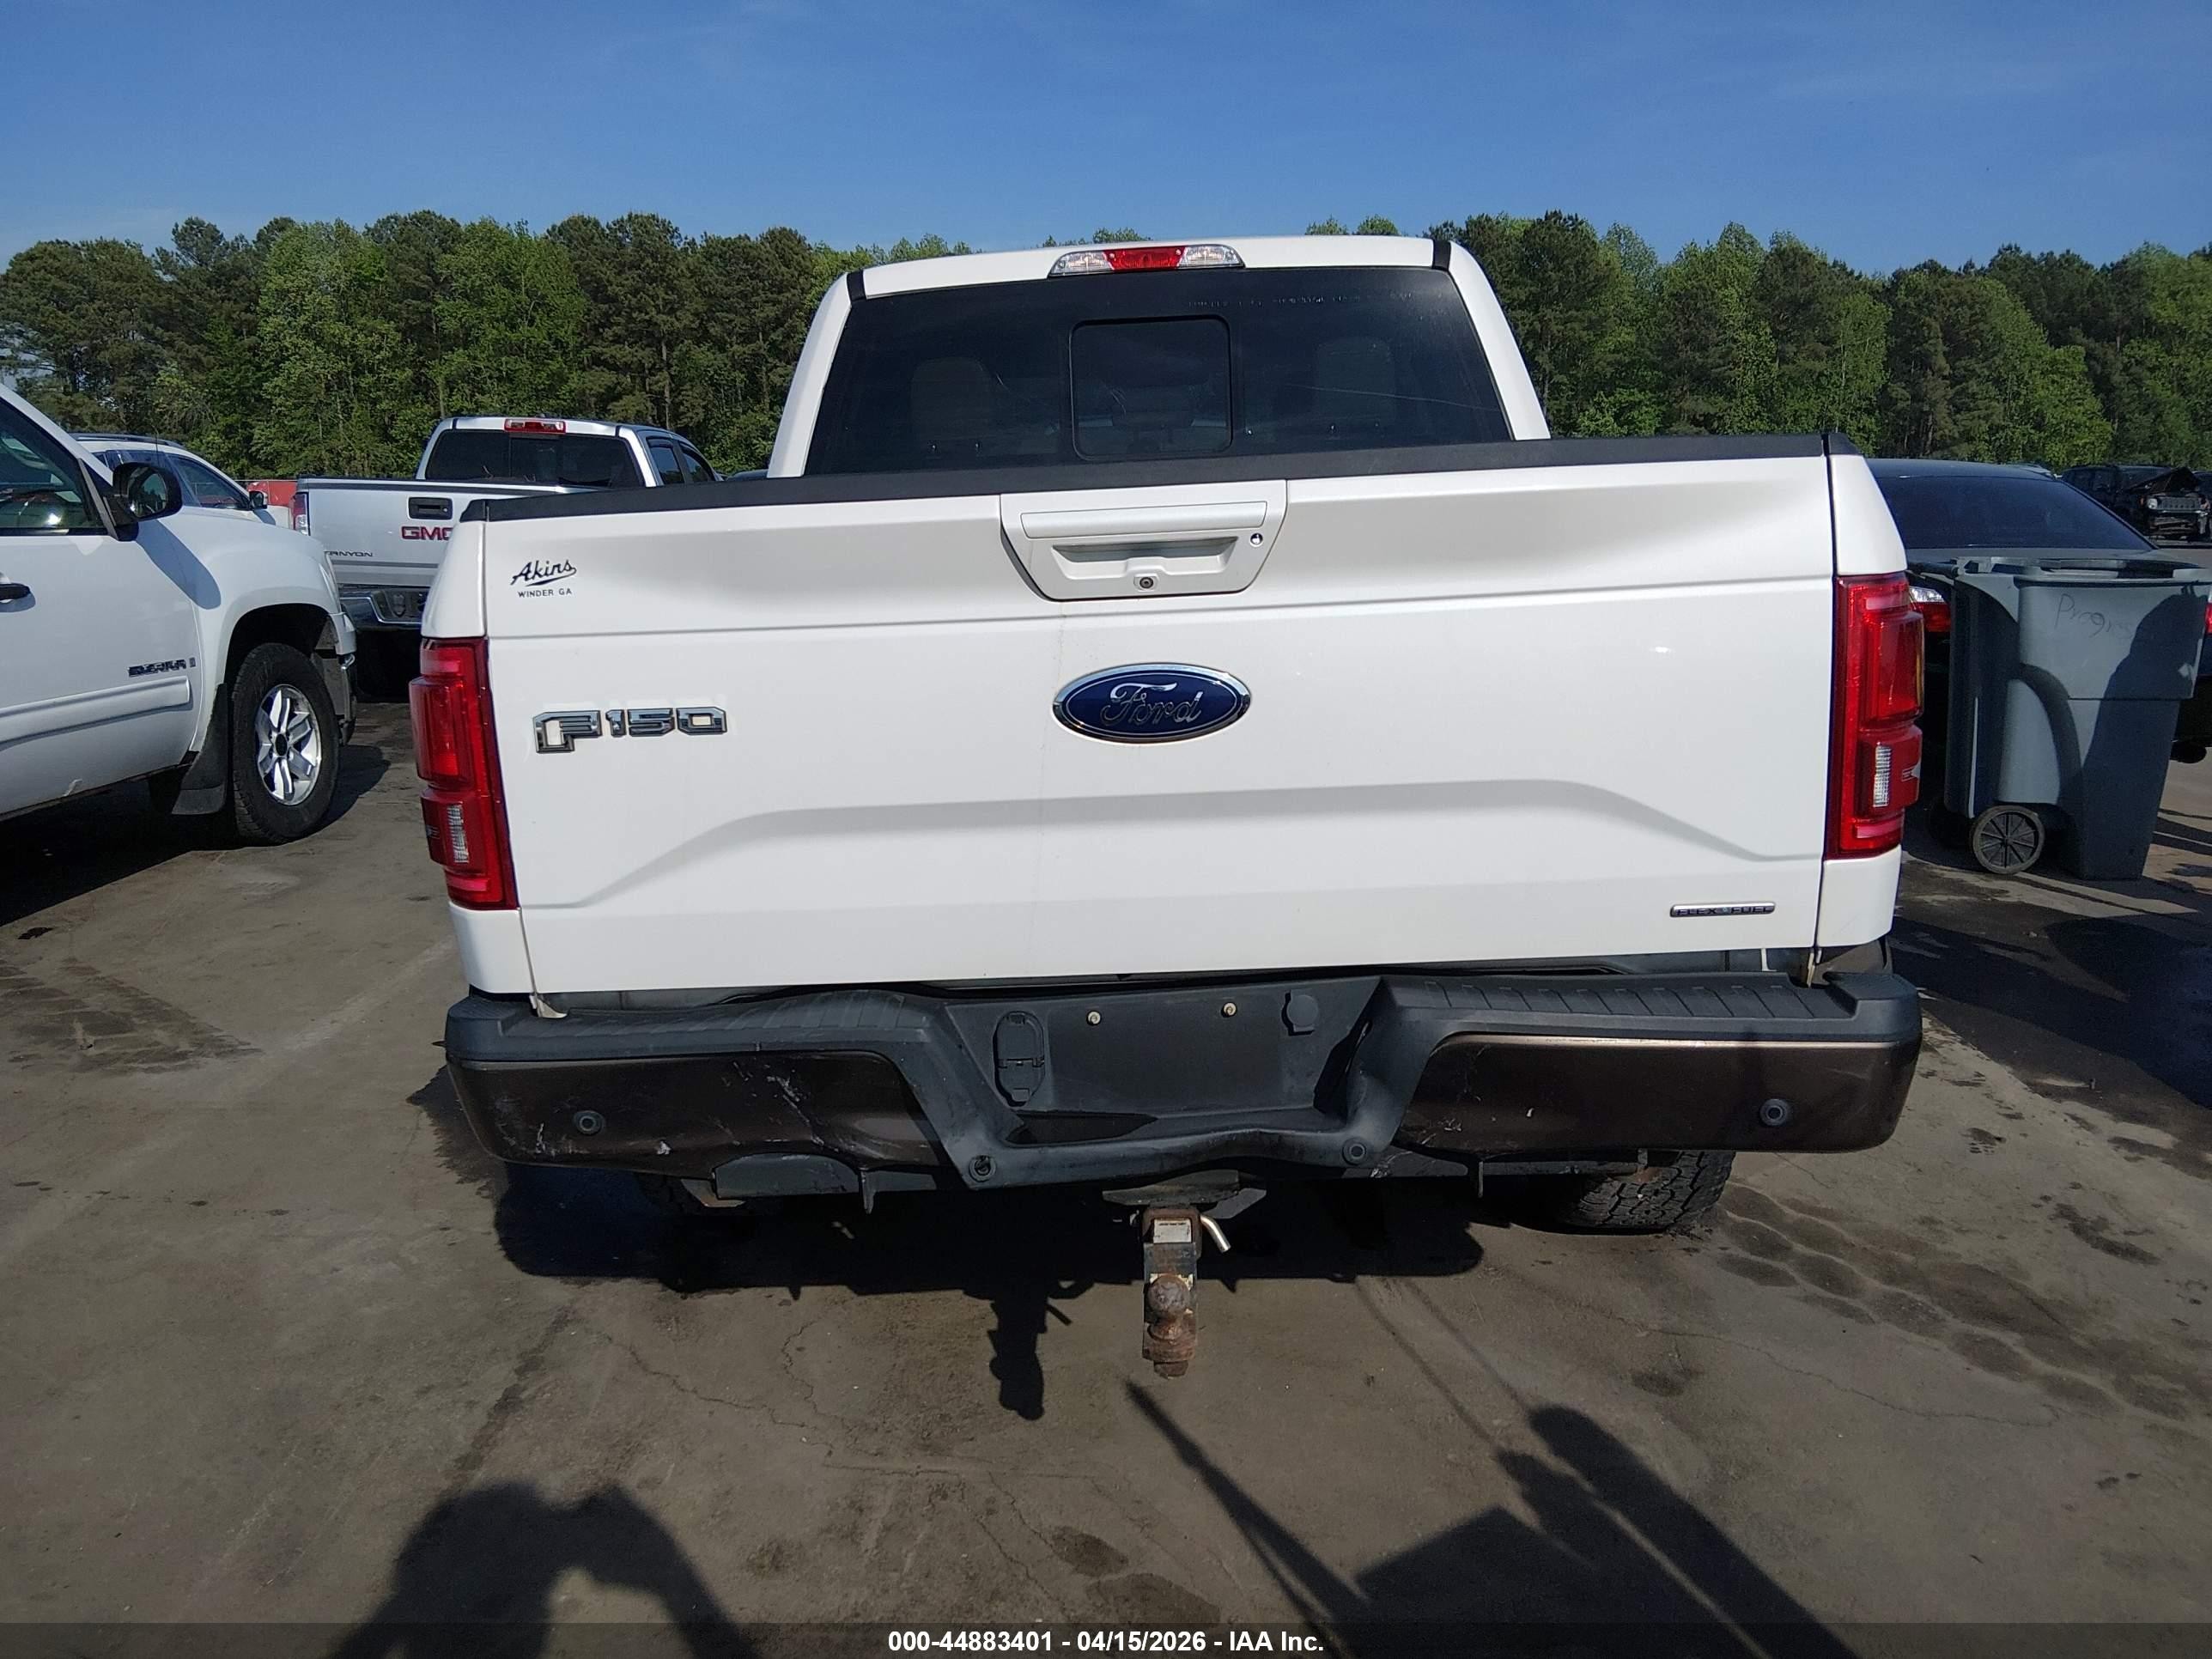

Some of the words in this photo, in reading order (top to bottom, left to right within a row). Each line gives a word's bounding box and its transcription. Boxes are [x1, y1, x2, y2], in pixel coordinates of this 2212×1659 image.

[510, 559, 577, 586] Akins
[517, 589, 554, 598] WINDER
[558, 587, 573, 596] GA
[1099, 682, 1204, 726] Ford
[1675, 908, 1717, 917] FLEX
[1730, 905, 1775, 915] FUEL
